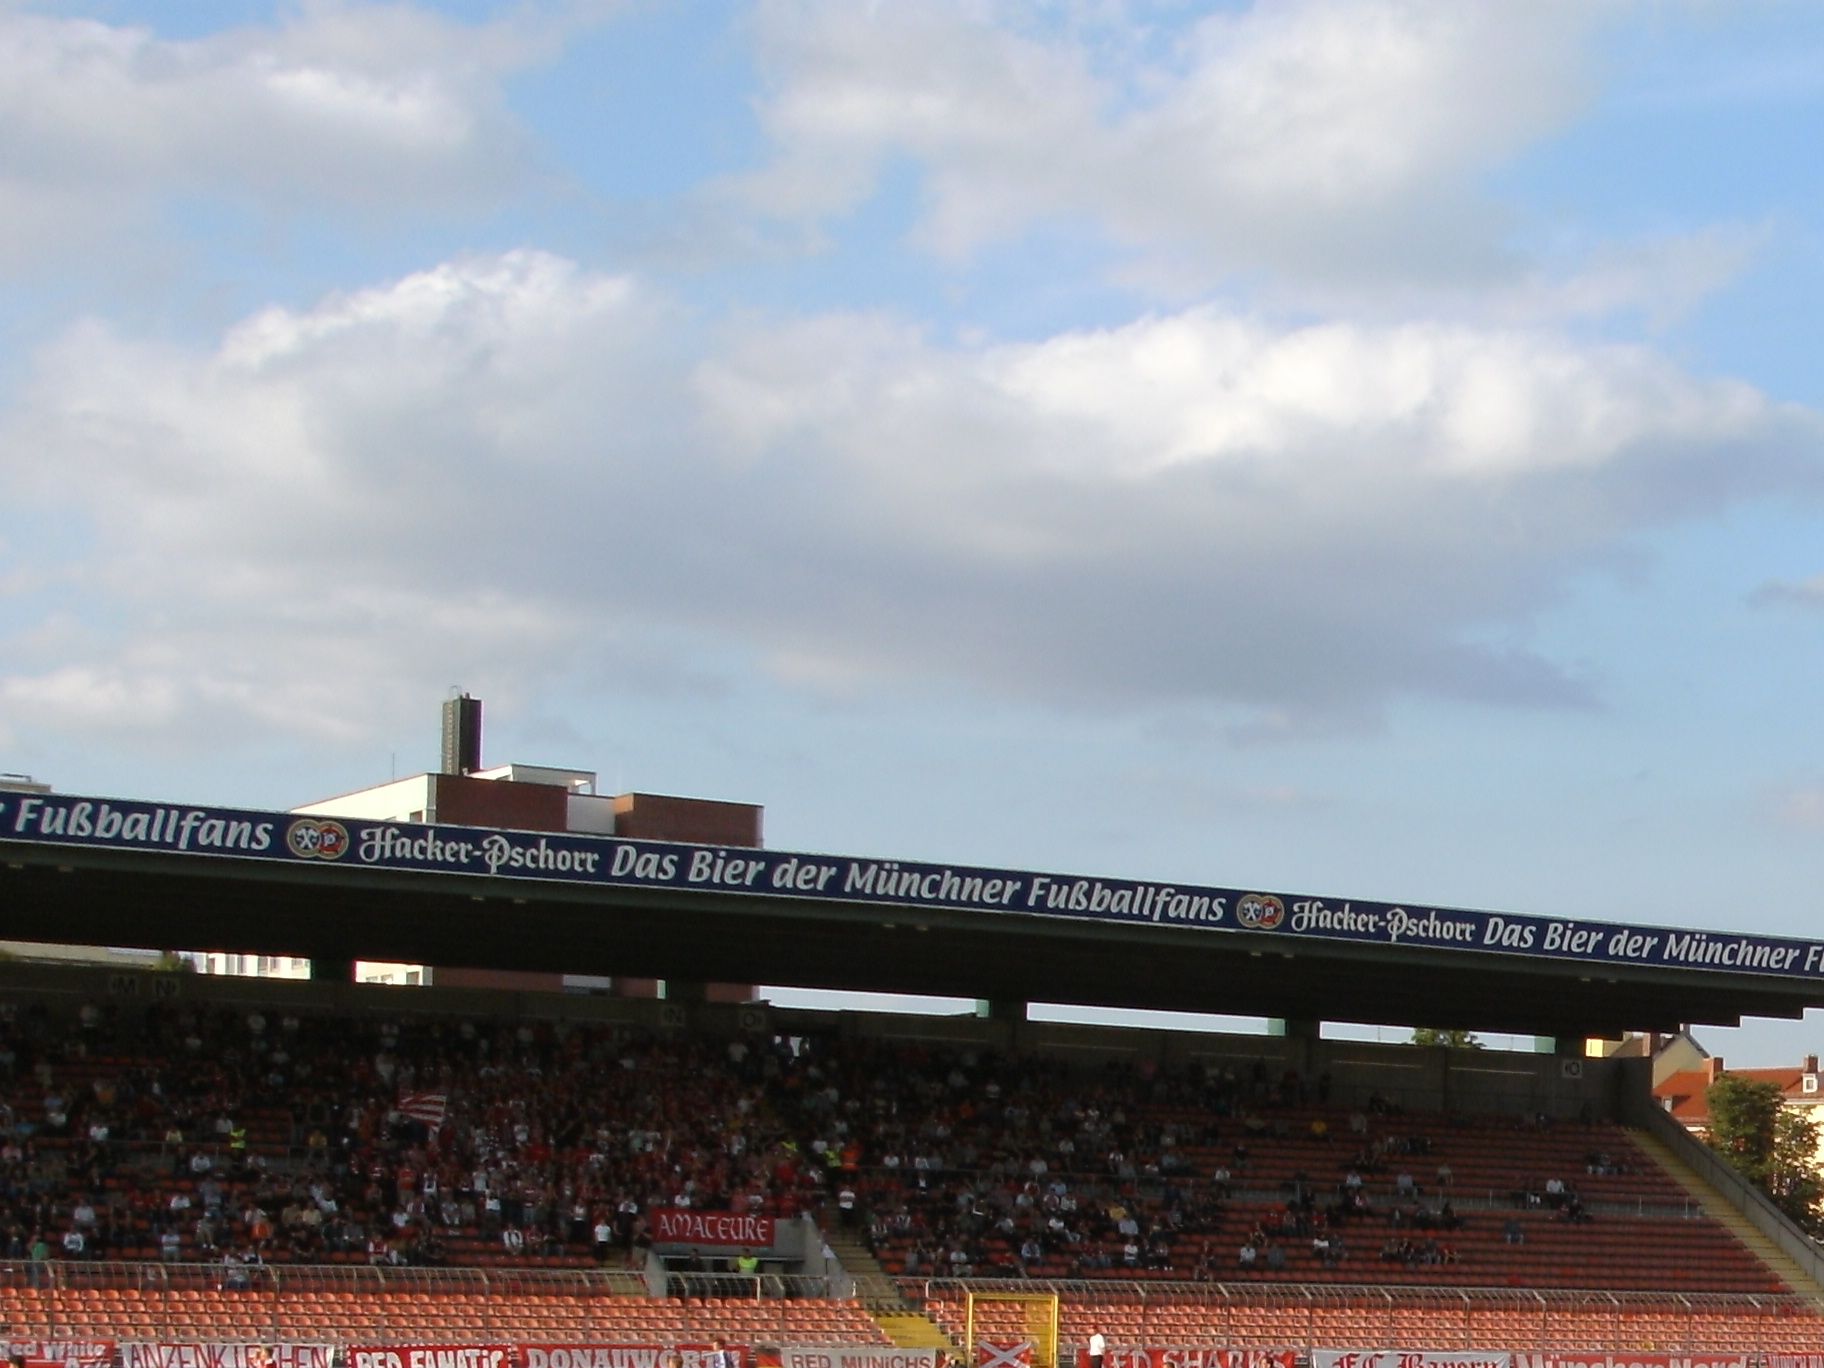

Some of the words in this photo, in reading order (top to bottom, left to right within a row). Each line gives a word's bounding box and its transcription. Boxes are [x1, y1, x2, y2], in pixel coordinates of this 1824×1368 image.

[15, 798, 274, 852] Fußballfans
[359, 825, 600, 876] Hacker-Pschorr
[610, 844, 677, 882] Das
[688, 850, 765, 888] Bier
[772, 857, 836, 893] der
[844, 861, 1022, 907] Münchner
[1027, 876, 1227, 922] Fußballfans
[1291, 902, 1477, 943] Hacker-Pschorr
[1483, 916, 1535, 948] Das
[1543, 922, 1603, 955] Bier
[1608, 927, 1657, 958] der
[1663, 932, 1800, 971] Münchner
